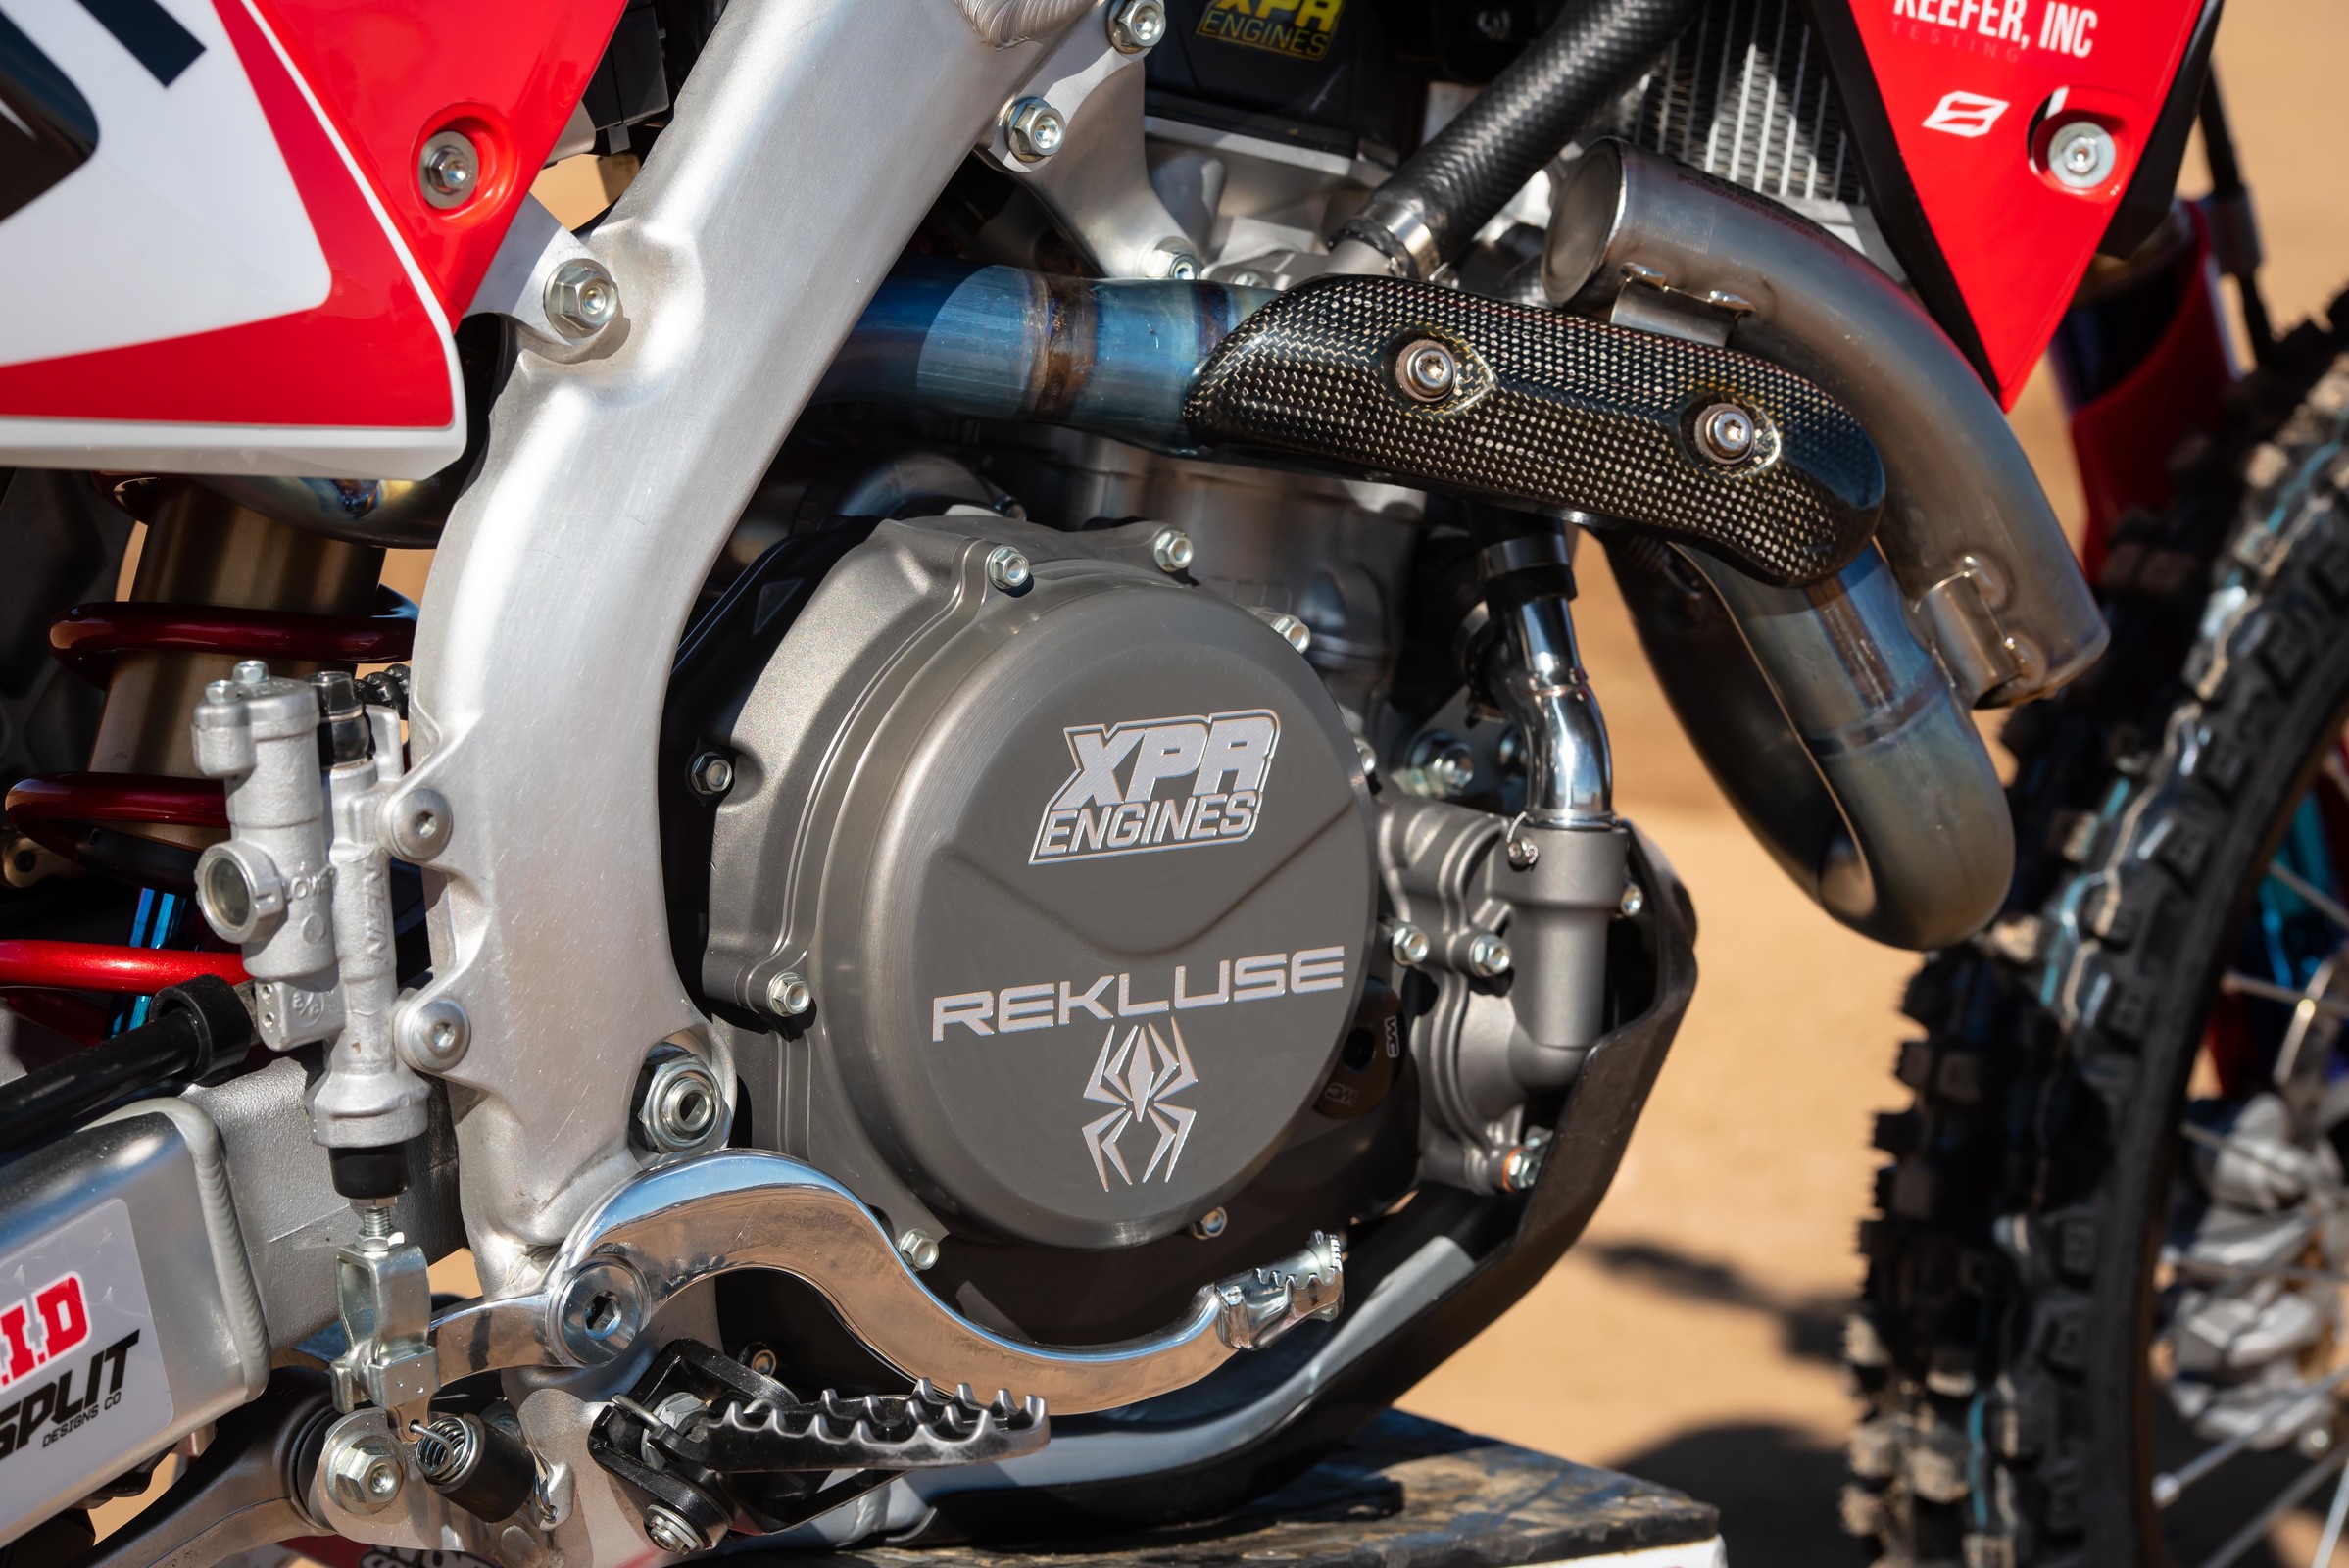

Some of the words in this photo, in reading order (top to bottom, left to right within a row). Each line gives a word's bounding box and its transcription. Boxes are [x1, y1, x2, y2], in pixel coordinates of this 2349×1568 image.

[1202, 10, 1330, 56] ENGINES
[1892, 20, 2020, 63] TESTING
[2038, 1, 2098, 58] INC
[1052, 717, 1274, 810] XPR
[1039, 790, 1257, 856] ENGINES
[932, 946, 1346, 1042] REKLUSE
[42, 1403, 100, 1448] DESIGNS
[103, 1390, 122, 1412] CO
